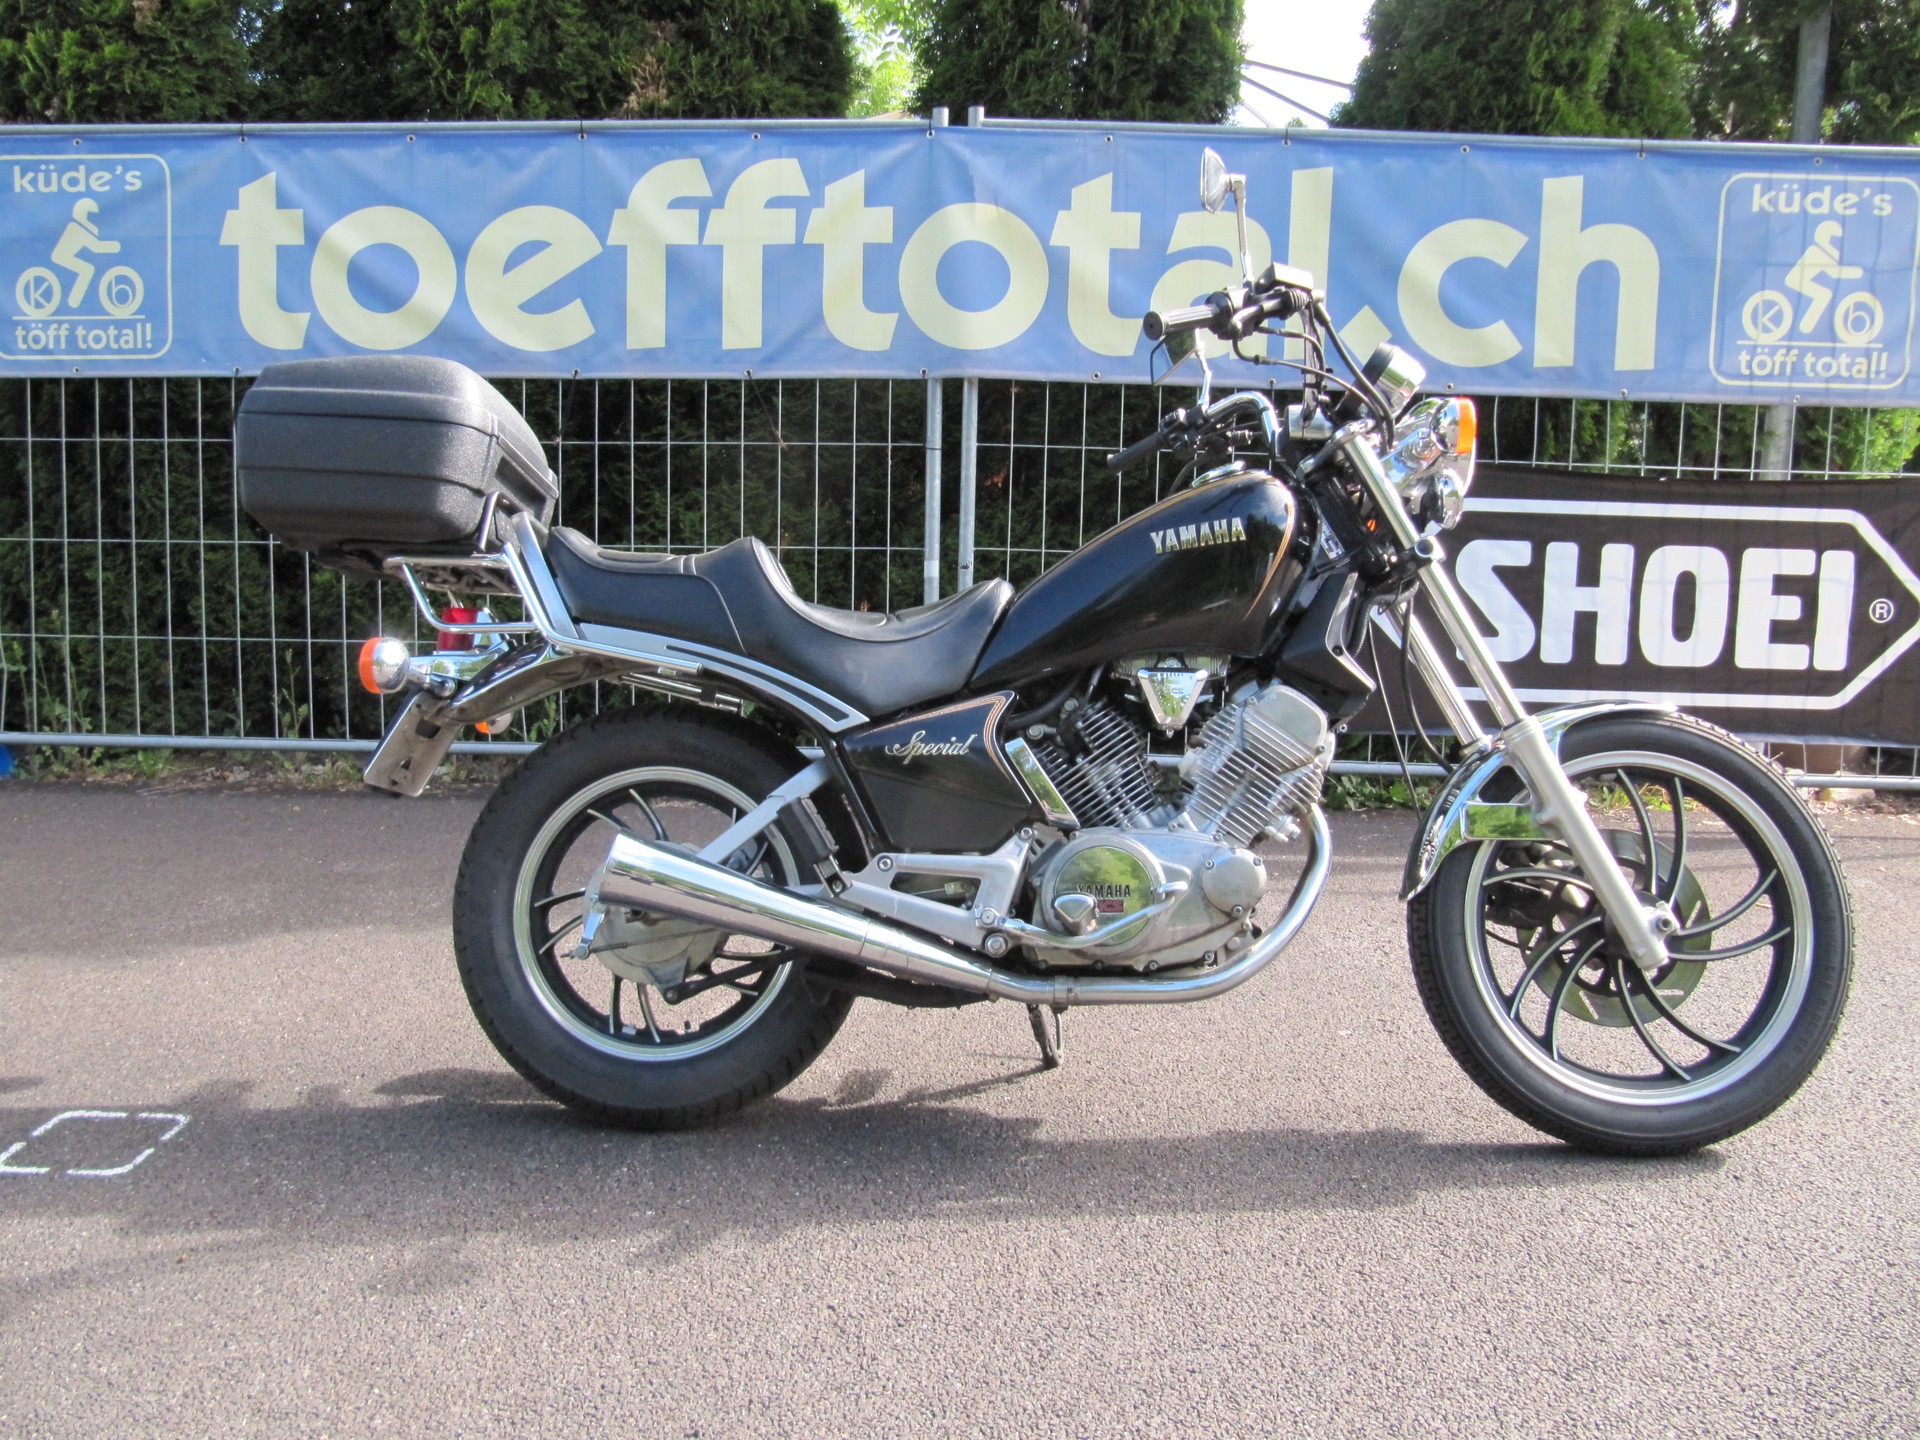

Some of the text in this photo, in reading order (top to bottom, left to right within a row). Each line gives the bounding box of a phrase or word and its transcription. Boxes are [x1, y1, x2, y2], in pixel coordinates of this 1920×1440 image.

[13, 164, 142, 193] küde's
[1752, 183, 1893, 216] küde's
[219, 157, 1660, 371] toefftotal.ch
[15, 322, 152, 349] töff total!
[1738, 347, 1888, 379] töff total!
[1150, 517, 1246, 554] YAMAHA
[1455, 538, 1855, 671] SHOEI
[885, 730, 978, 765] Special
[1077, 883, 1131, 898] YAMAHA
